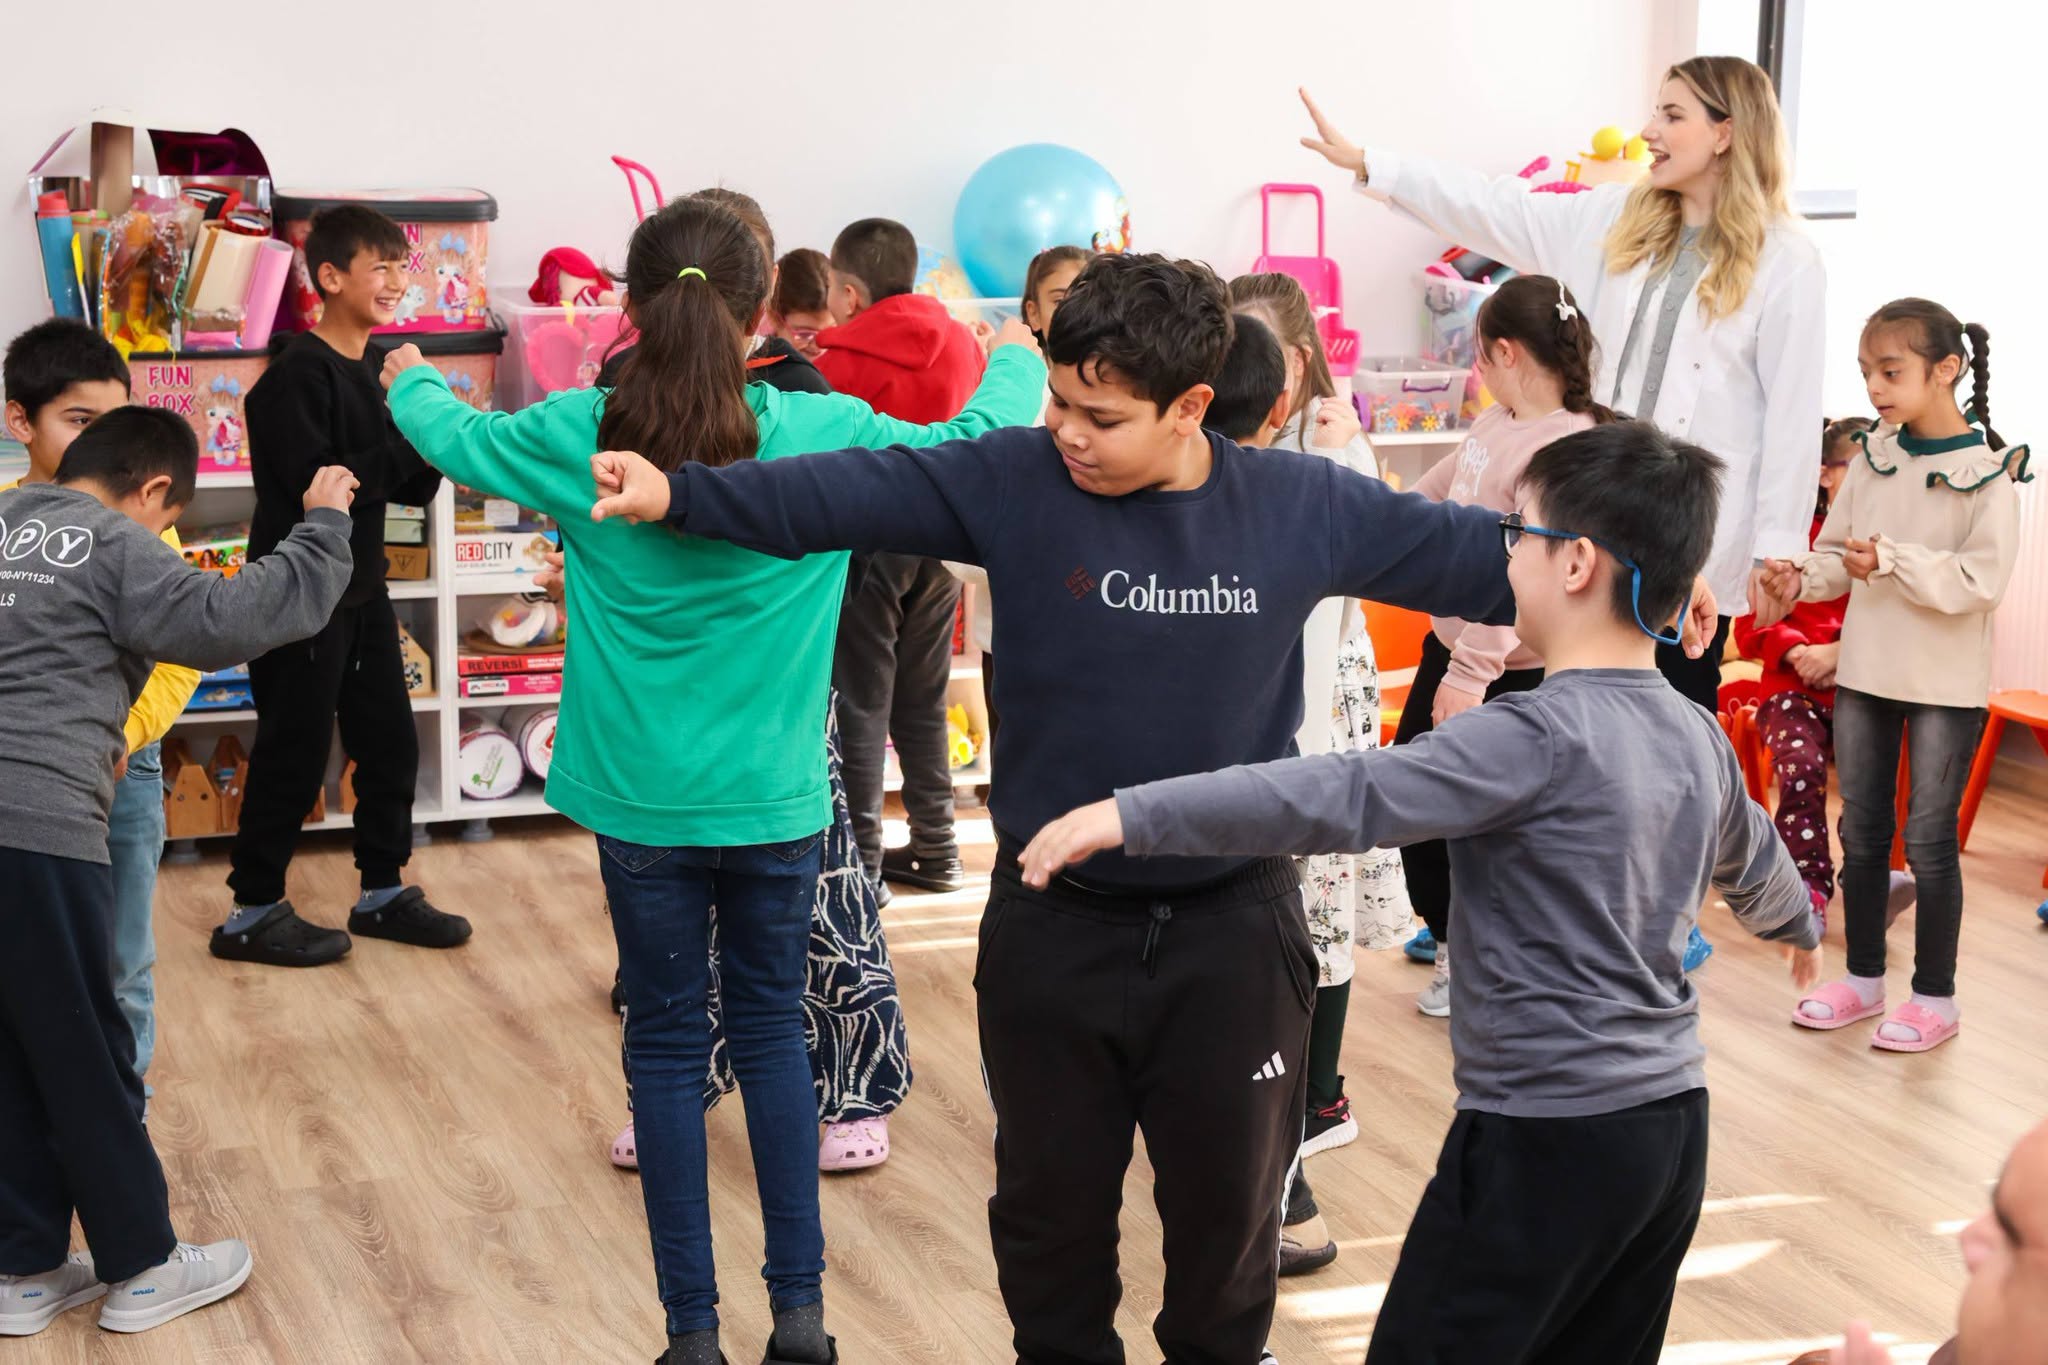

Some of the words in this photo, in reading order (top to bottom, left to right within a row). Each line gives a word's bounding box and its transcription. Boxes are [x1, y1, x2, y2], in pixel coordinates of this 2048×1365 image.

[147, 365, 192, 388] FUN
[147, 394, 195, 414] BOX
[0, 570, 55, 585] 00-NY11234
[1100, 569, 1260, 614] Columbia
